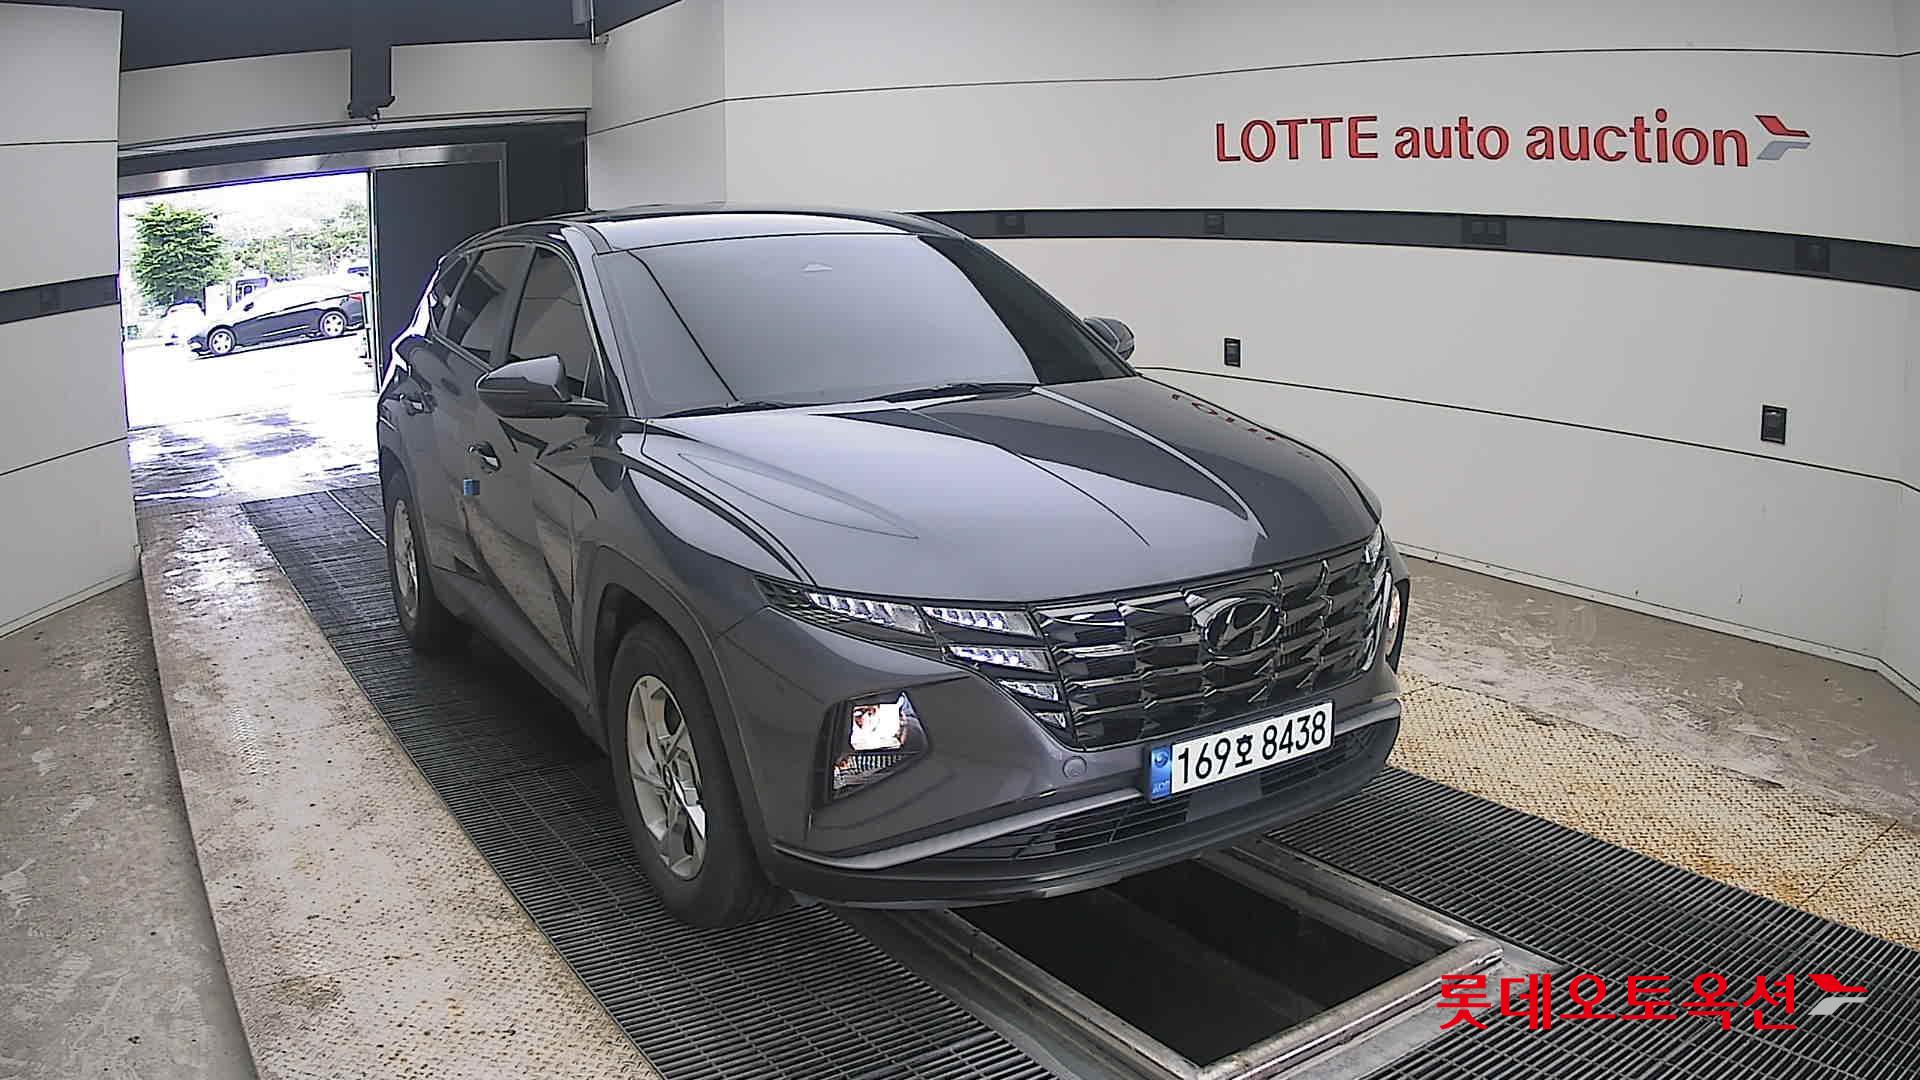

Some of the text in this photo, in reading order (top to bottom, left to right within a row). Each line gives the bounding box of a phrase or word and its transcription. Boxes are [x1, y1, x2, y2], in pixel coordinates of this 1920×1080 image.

[1215, 108, 1750, 167] LOTTE auto auction
[1261, 710, 1327, 761] 8438
